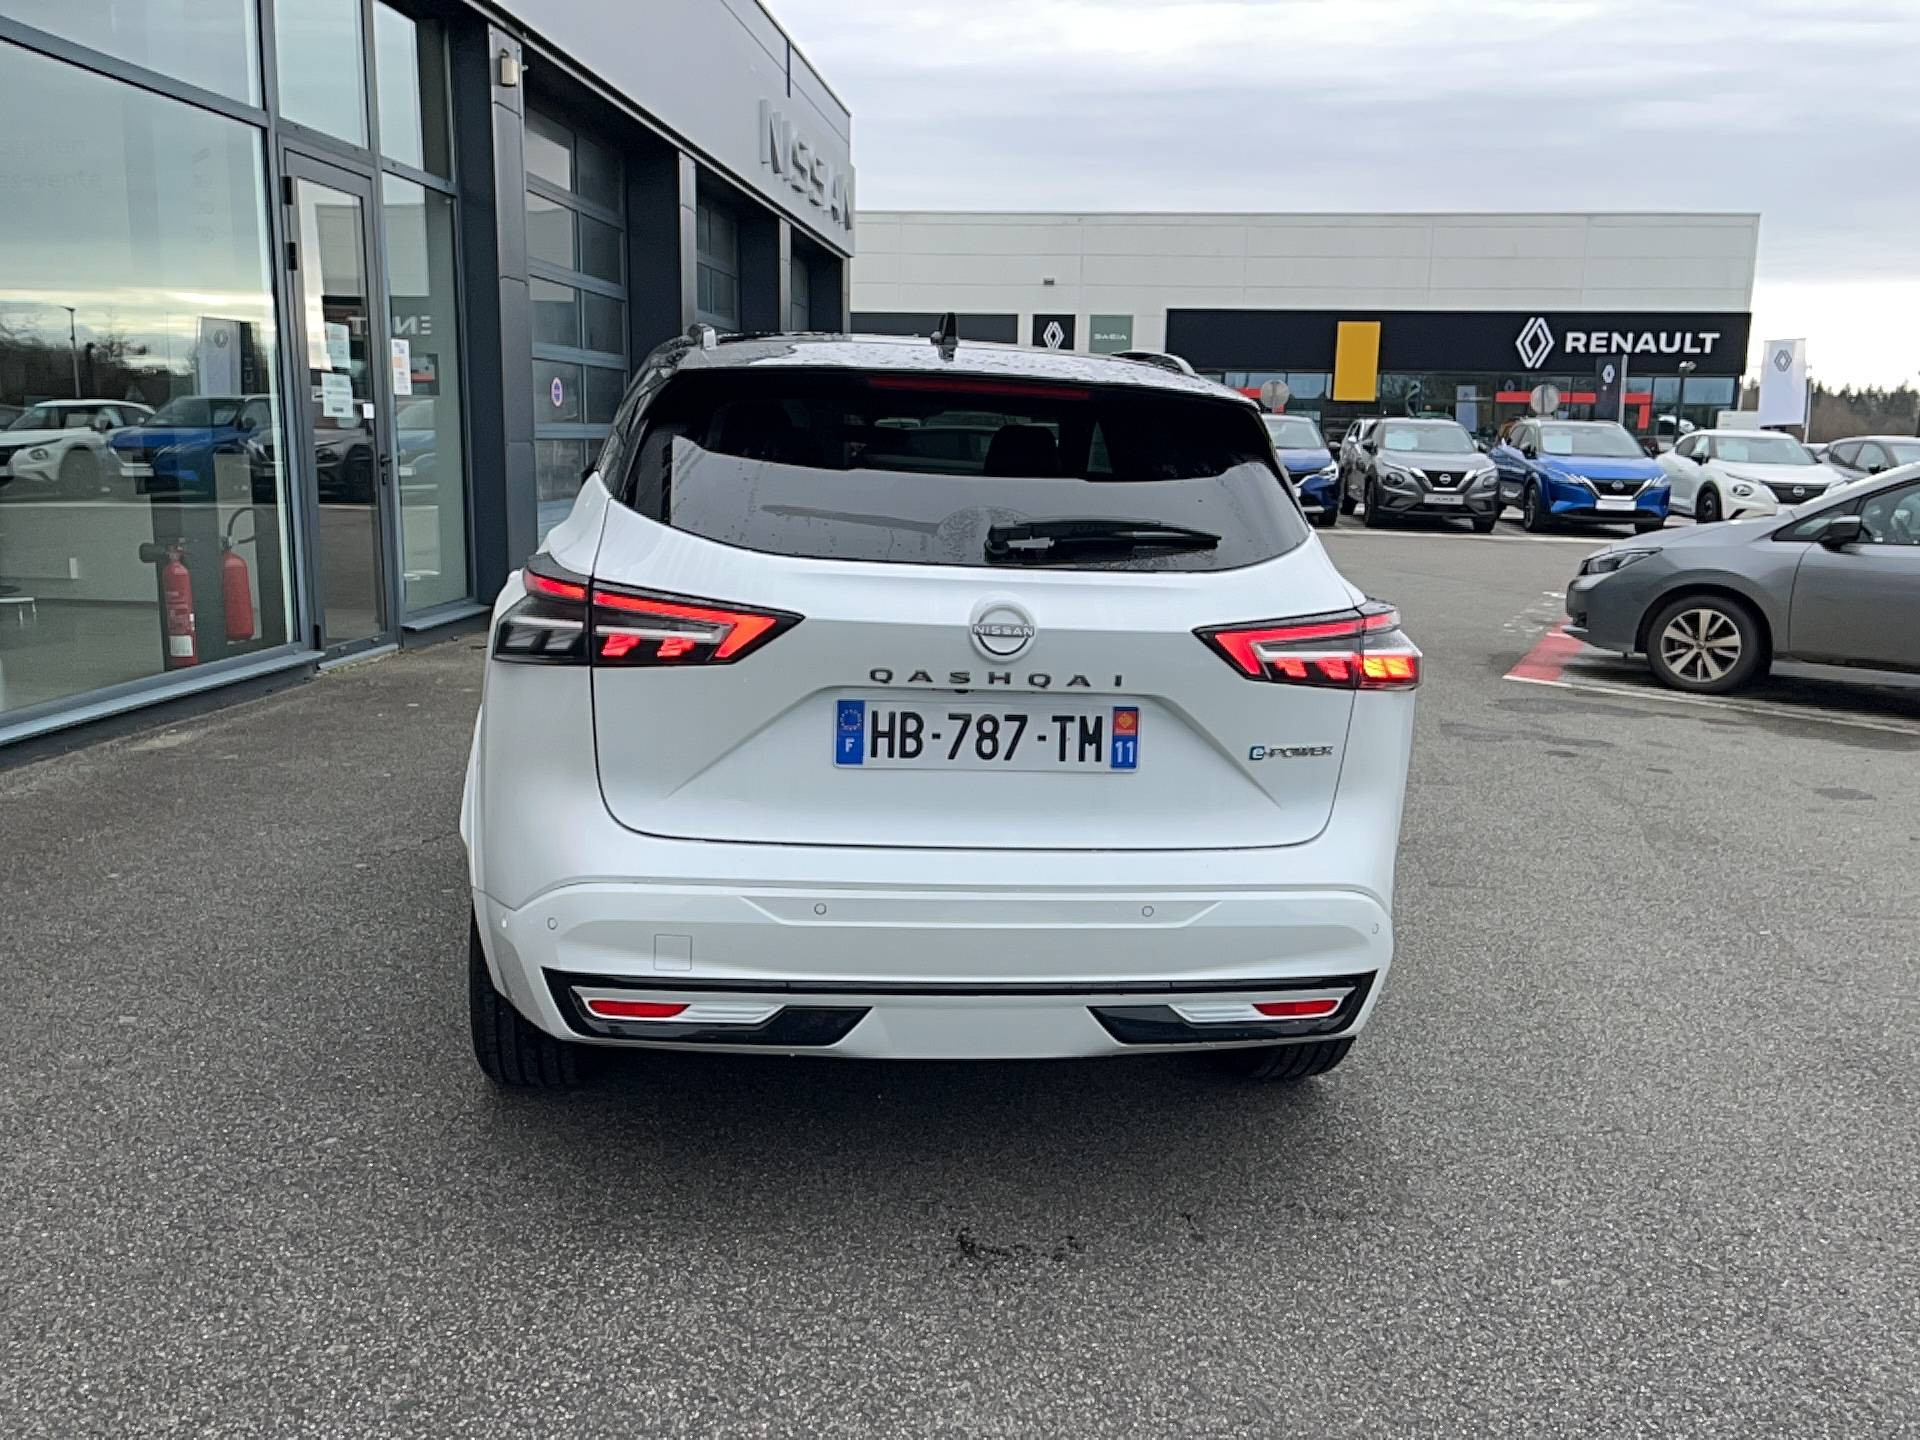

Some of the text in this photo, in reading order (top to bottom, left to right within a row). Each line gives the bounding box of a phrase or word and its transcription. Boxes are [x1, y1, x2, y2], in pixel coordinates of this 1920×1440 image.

[759, 98, 854, 231] NISSAN
[1565, 332, 1720, 353] RENAULT
[974, 624, 1034, 636] NISSAN
[870, 669, 1122, 688] QASHQAI
[845, 710, 1135, 763] F HB-787-TM 11
